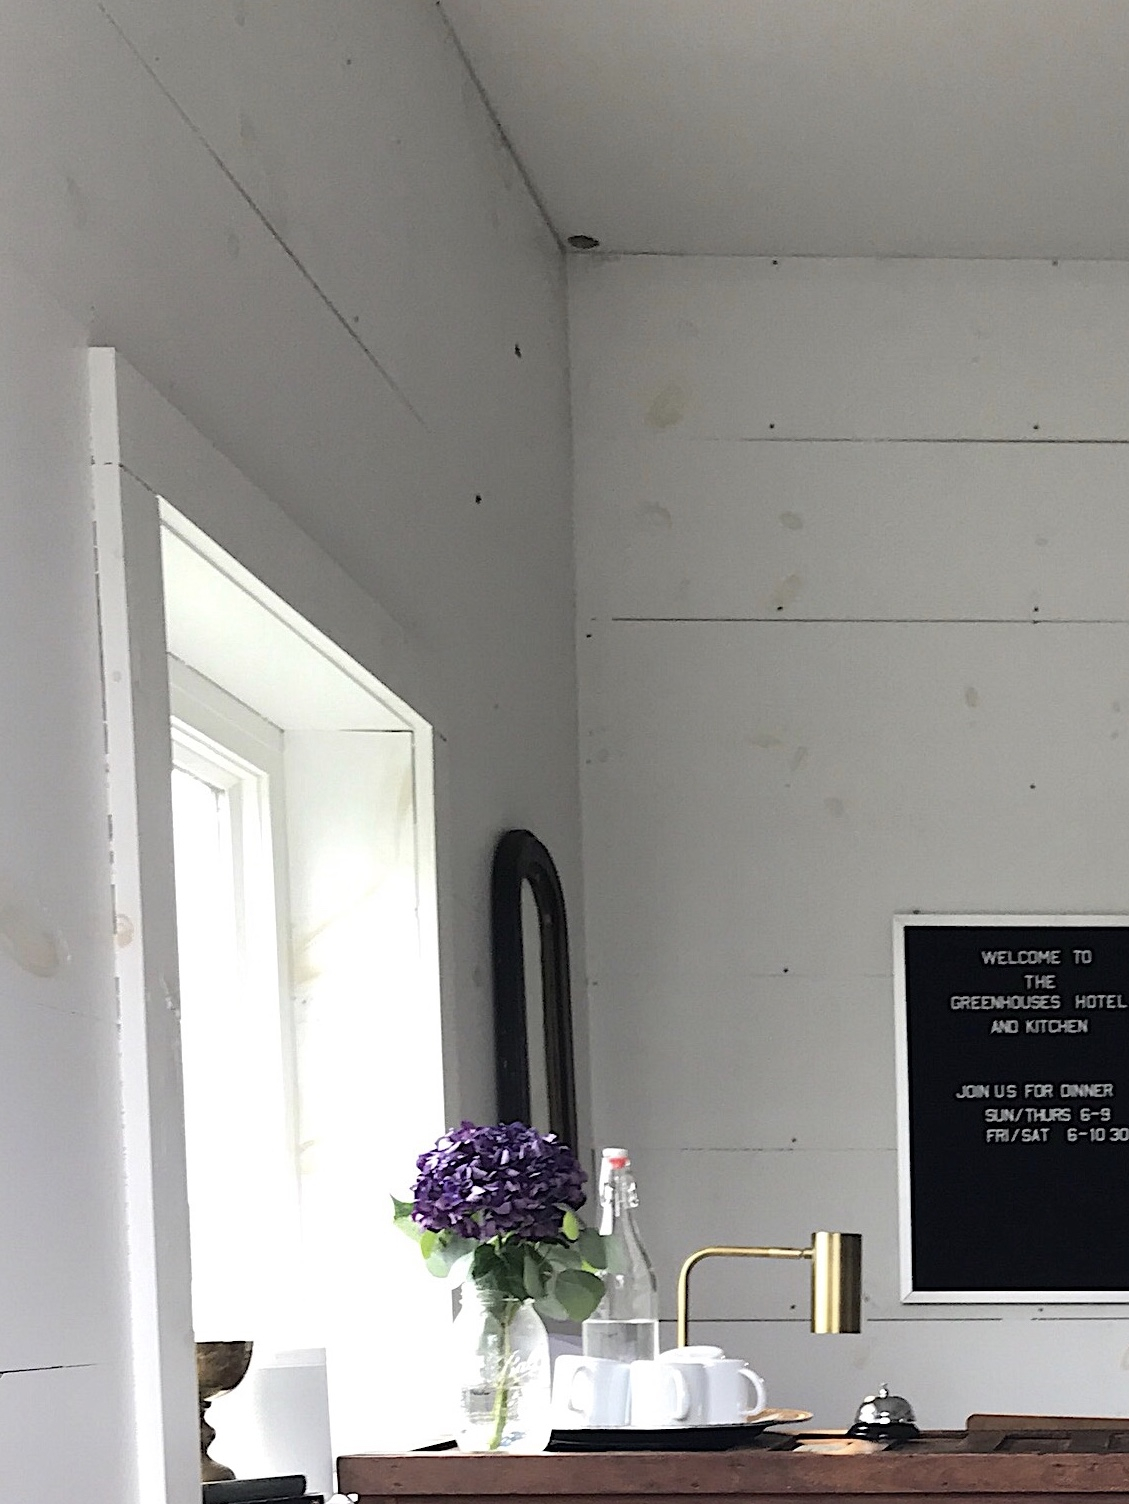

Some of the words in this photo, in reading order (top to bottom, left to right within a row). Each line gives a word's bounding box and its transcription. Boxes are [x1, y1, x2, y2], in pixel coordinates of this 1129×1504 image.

[981, 950, 1061, 965] WELCOME
[1073, 949, 1092, 964] TO
[1024, 974, 1056, 989] THE
[950, 995, 1061, 1010] GREENHOUSES
[1075, 994, 1128, 1009] HOTEL
[990, 1019, 1019, 1034] AND
[1025, 1019, 1088, 1034] KITCHEN
[956, 1084, 990, 1099] JOIN
[993, 1084, 1017, 1098] US
[1024, 1083, 1054, 1098] FOR
[1060, 1083, 1114, 1098] DINNER
[984, 1108, 1071, 1122] SUN/THURS
[1079, 1107, 1111, 1122] 6-9
[986, 1127, 1050, 1143] FRI/SAT
